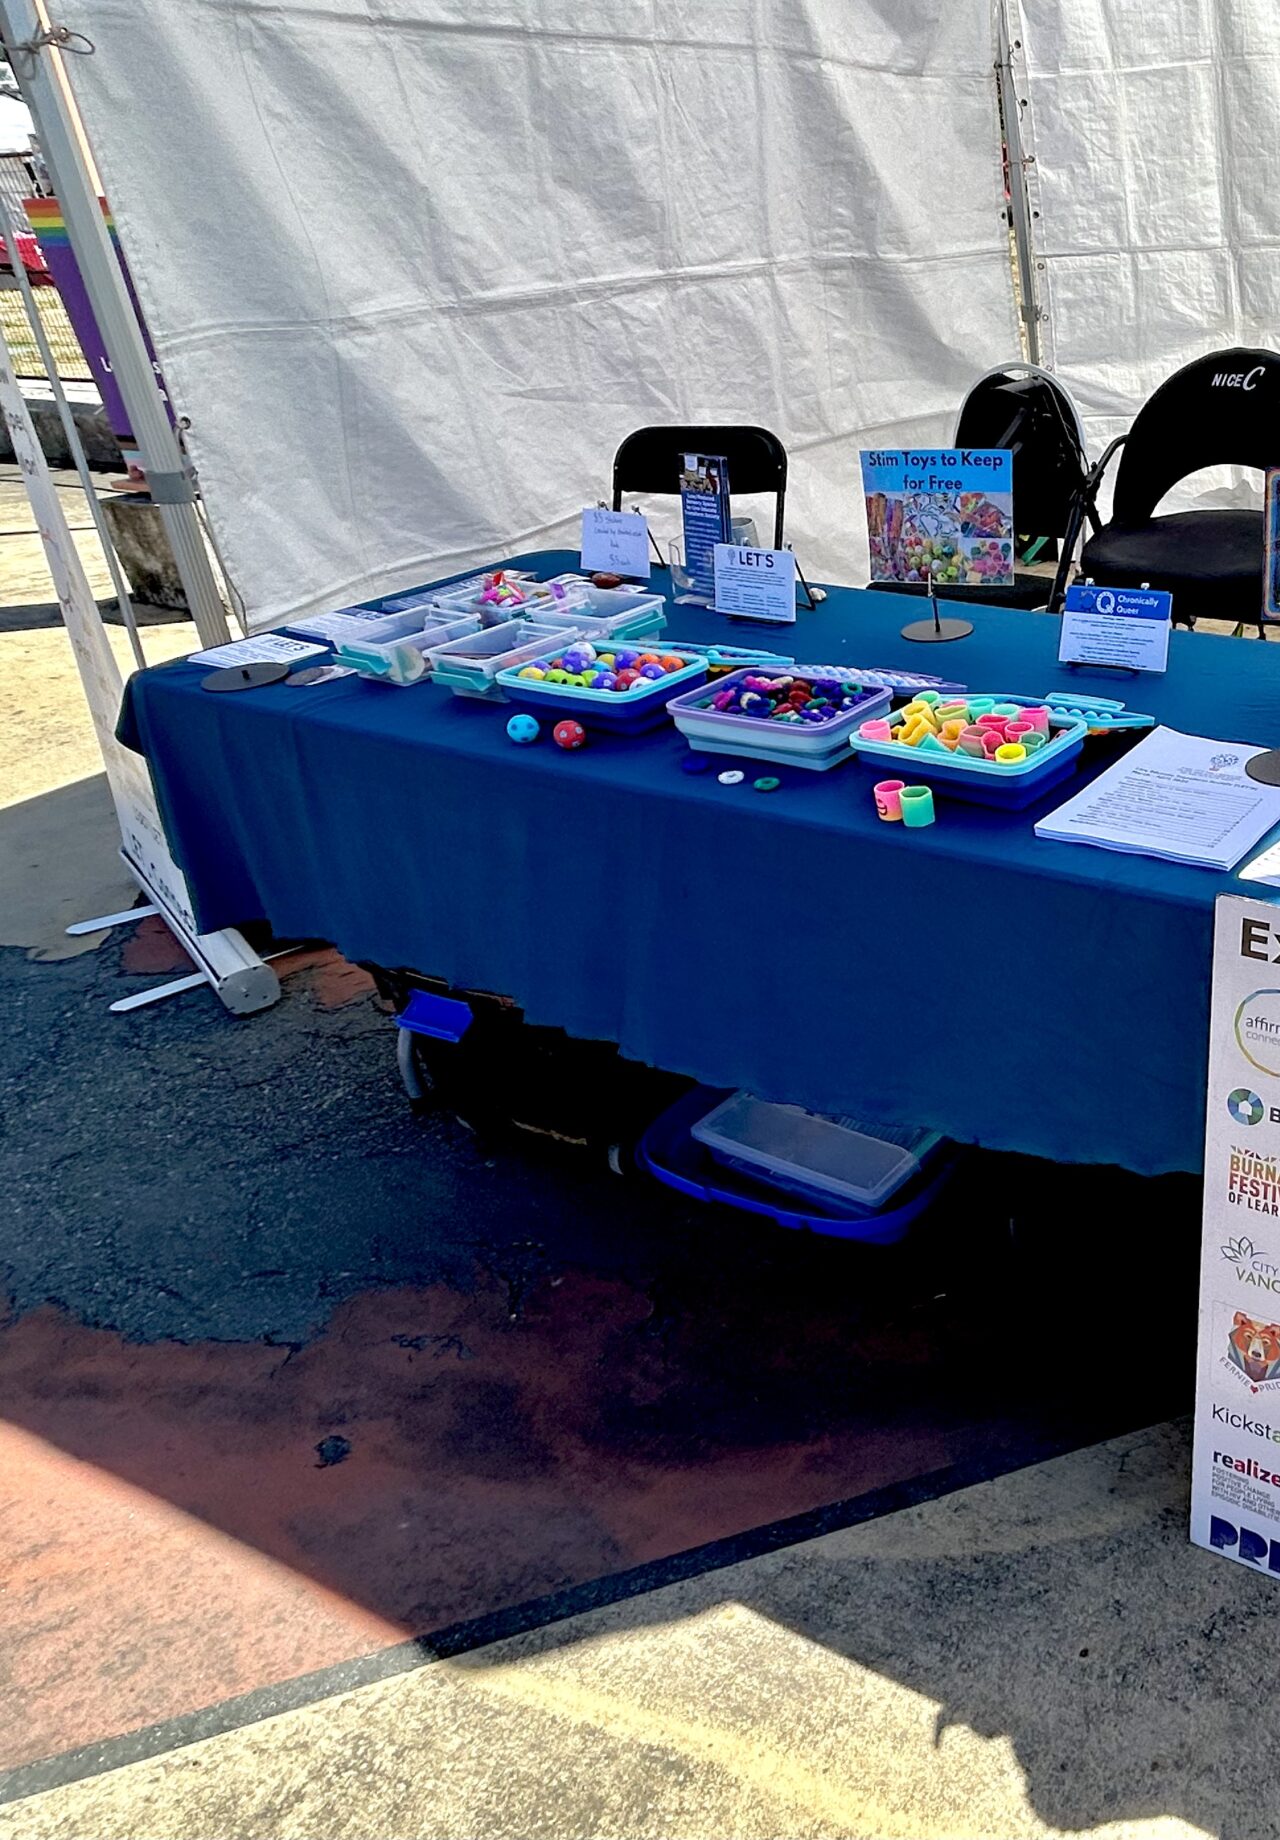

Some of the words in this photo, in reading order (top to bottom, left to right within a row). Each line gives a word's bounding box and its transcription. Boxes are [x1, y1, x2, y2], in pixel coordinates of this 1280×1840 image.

[868, 453, 899, 467] Stim
[902, 451, 936, 470] Toys
[940, 453, 957, 467] to
[961, 451, 1004, 470] Keep
[903, 475, 925, 489] for
[929, 476, 963, 490] Free
[739, 551, 774, 568] LET'S
[1117, 594, 1159, 608] Chronically
[1116, 605, 1139, 615] Queer
[1228, 1192, 1245, 1206] OF
[1252, 1260, 1277, 1278] CITY
[1218, 1356, 1251, 1387] FERNIE
